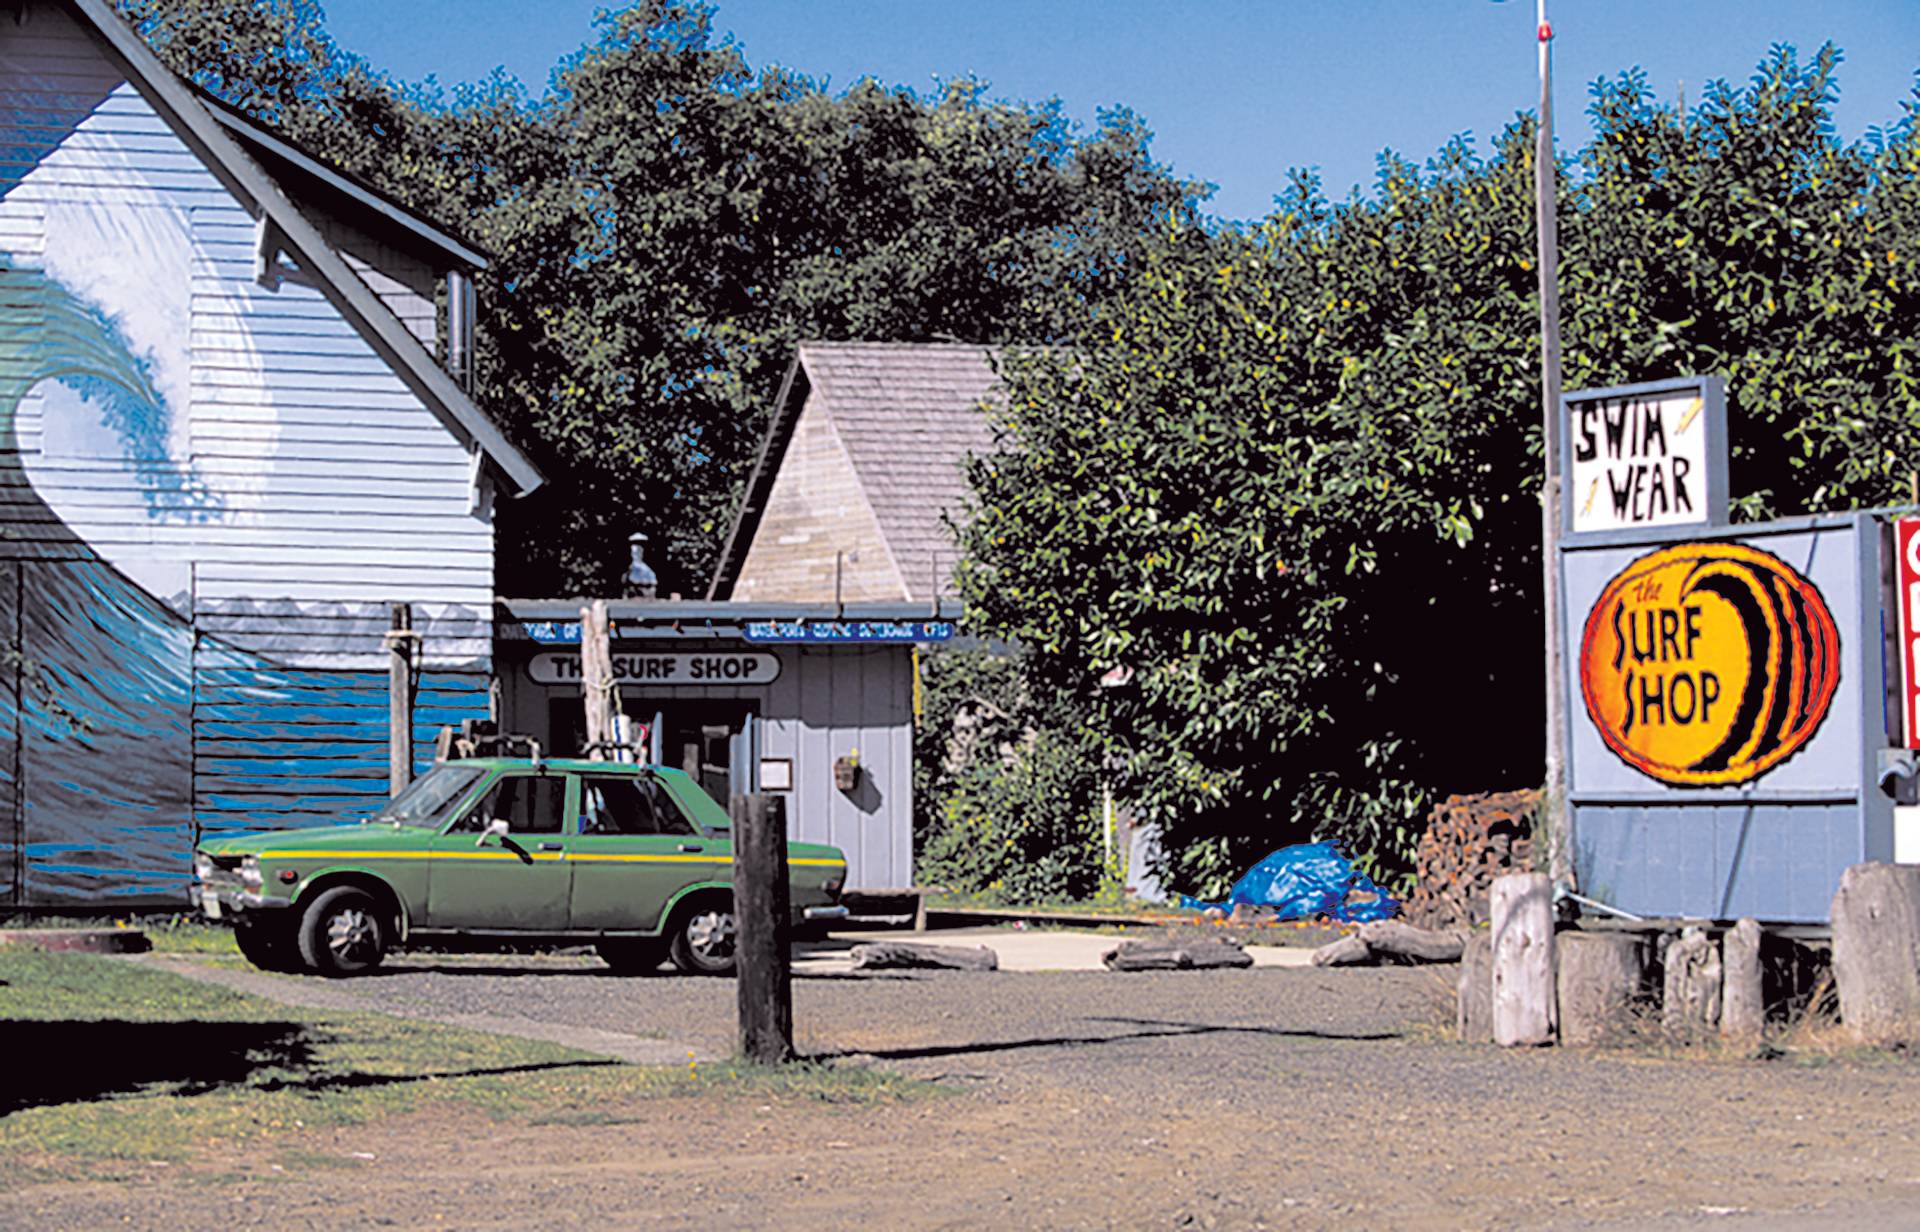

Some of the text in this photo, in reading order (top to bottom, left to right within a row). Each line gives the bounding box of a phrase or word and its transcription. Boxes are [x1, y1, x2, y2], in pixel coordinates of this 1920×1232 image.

[1576, 400, 1667, 462] SWIM
[1607, 456, 1692, 521] WEAR
[613, 658, 676, 678] SURF
[690, 658, 757, 678] SHOP
[1612, 598, 1702, 674] SURF
[1620, 667, 1720, 739] SHOP
